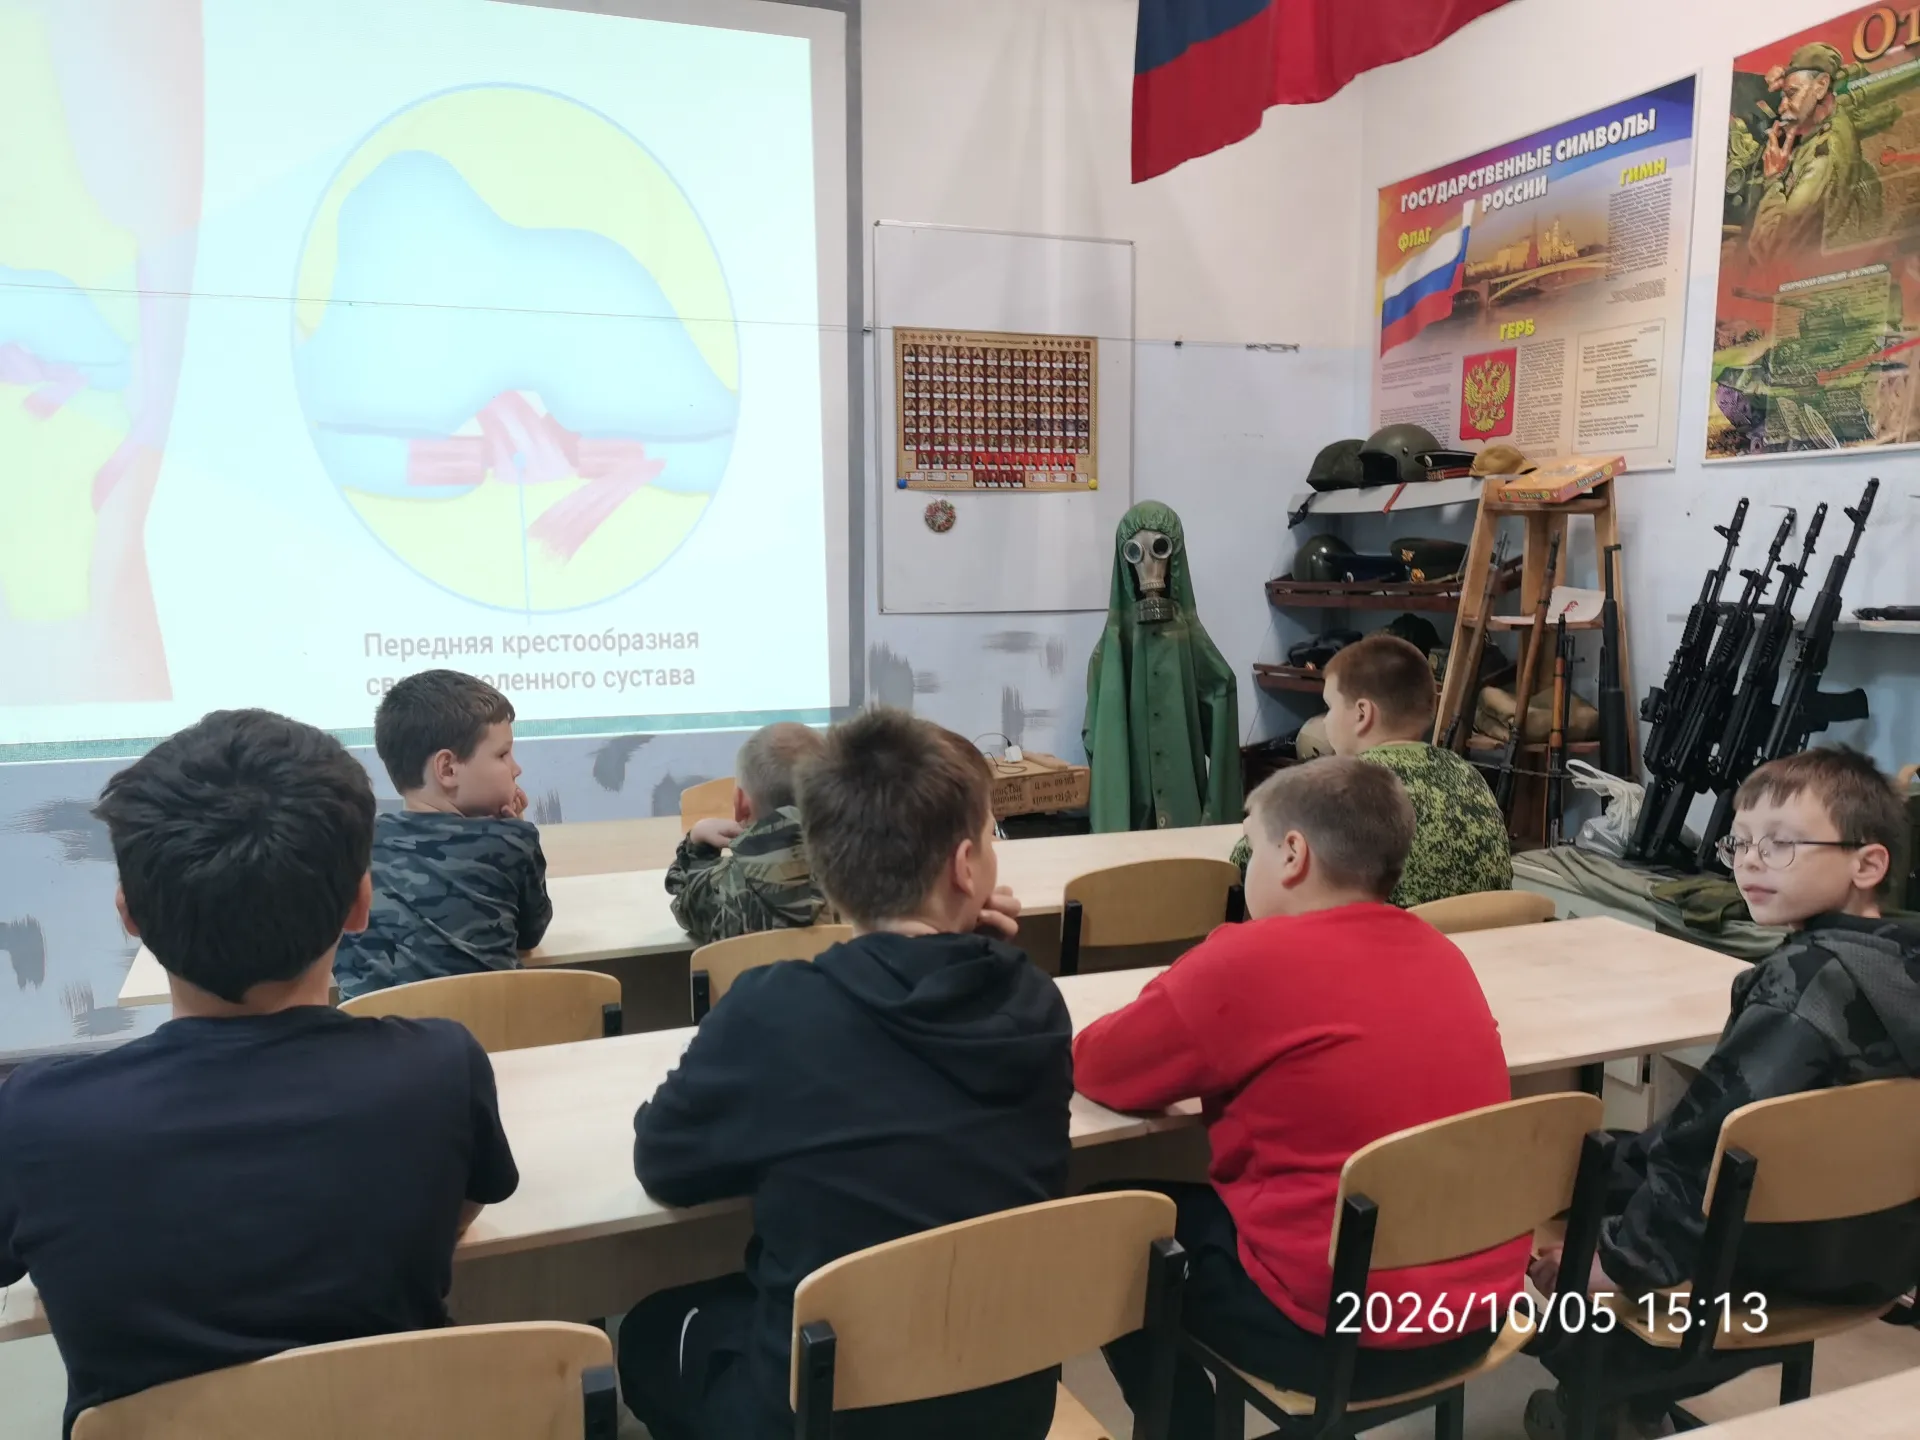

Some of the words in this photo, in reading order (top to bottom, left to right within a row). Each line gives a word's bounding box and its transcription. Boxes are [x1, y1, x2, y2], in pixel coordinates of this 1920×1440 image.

[1401, 144, 1552, 213] ГОСУДАРСТВЕННЫЕ
[1555, 108, 1657, 162] СИМВОЛЫ
[1620, 158, 1667, 187] ГИМН
[1482, 175, 1548, 213] РОССИИ
[1398, 226, 1432, 252] ФЛАГ
[1500, 318, 1535, 342] ГЕРБ
[364, 632, 494, 662] Передняя
[502, 627, 699, 660] крестообразная
[474, 670, 596, 692] оленного
[603, 668, 696, 694] сустава
